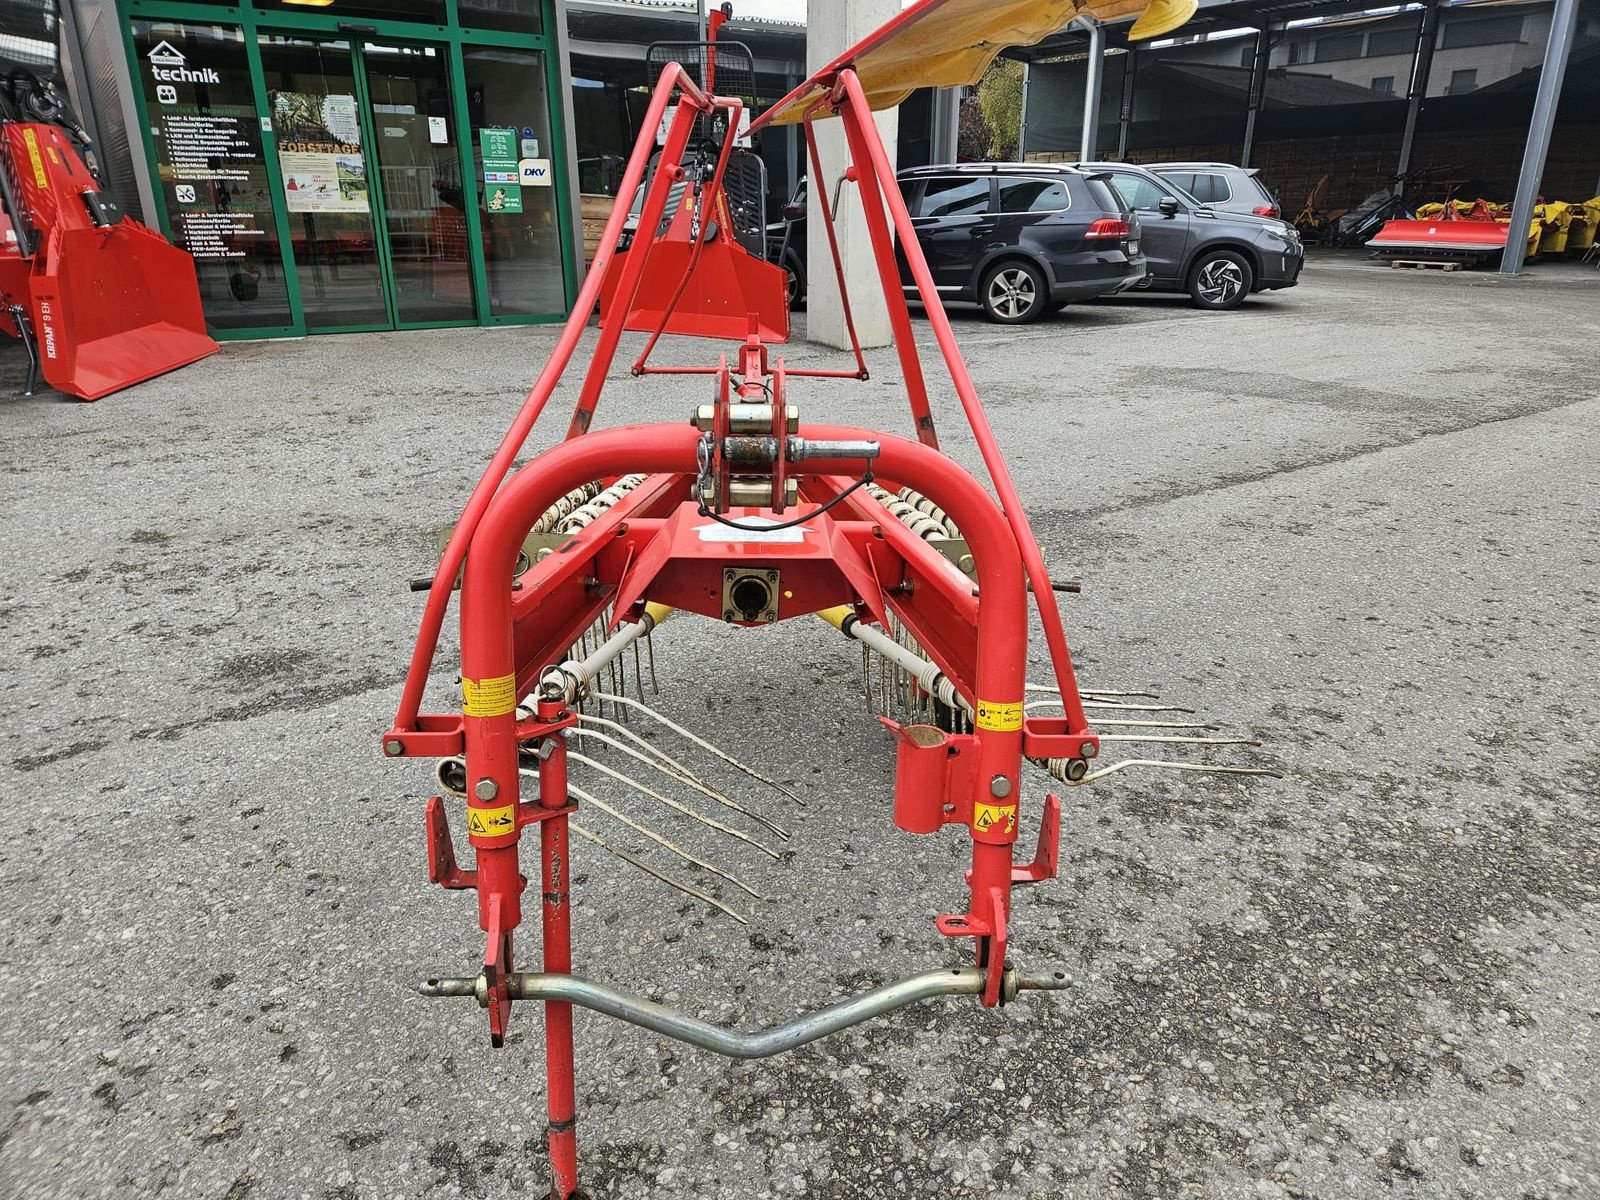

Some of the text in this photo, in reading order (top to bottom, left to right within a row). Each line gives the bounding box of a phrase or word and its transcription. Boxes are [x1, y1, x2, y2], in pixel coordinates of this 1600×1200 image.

[152, 65, 220, 84] technik
[279, 142, 359, 154] FORSTTAGE
[524, 168, 546, 176] DKV
[41, 302, 50, 314] EH
